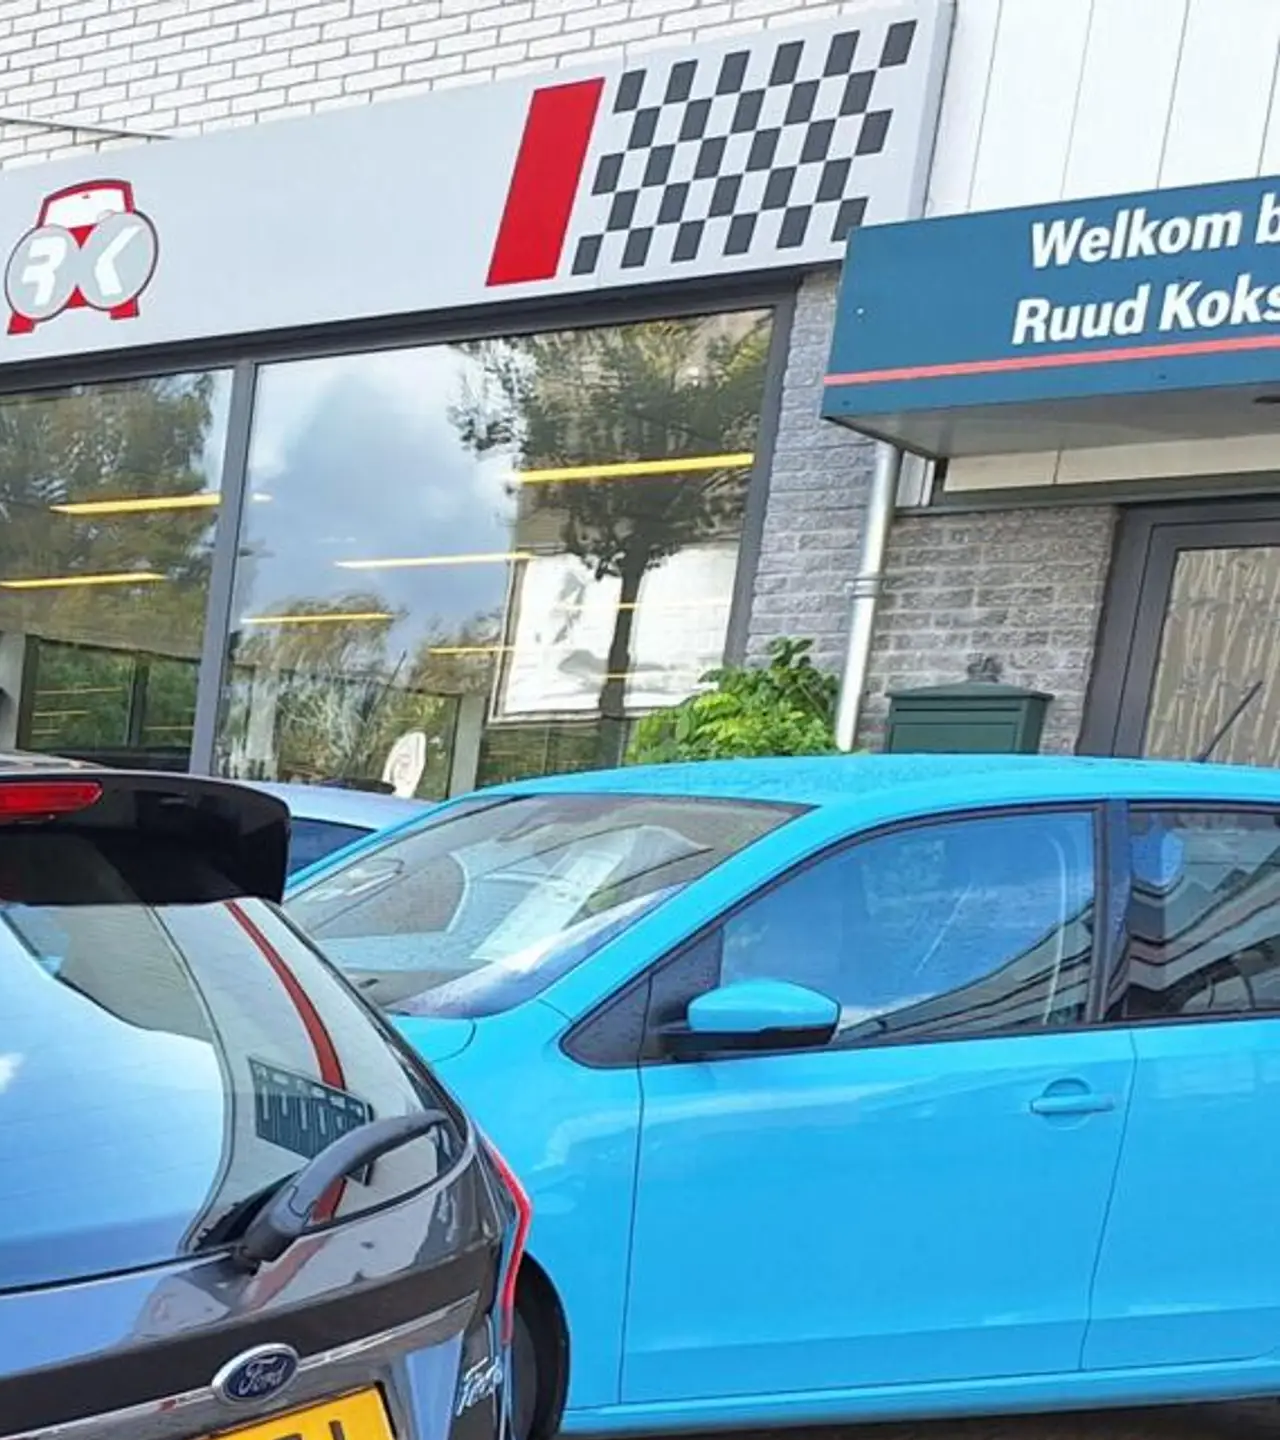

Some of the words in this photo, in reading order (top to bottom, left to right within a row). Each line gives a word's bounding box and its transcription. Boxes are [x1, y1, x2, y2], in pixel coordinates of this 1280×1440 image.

[1029, 207, 1244, 269] Welkom
[1011, 283, 1151, 346] Ruud
[1159, 273, 1280, 332] Koks
[238, 1356, 289, 1396] Ford
